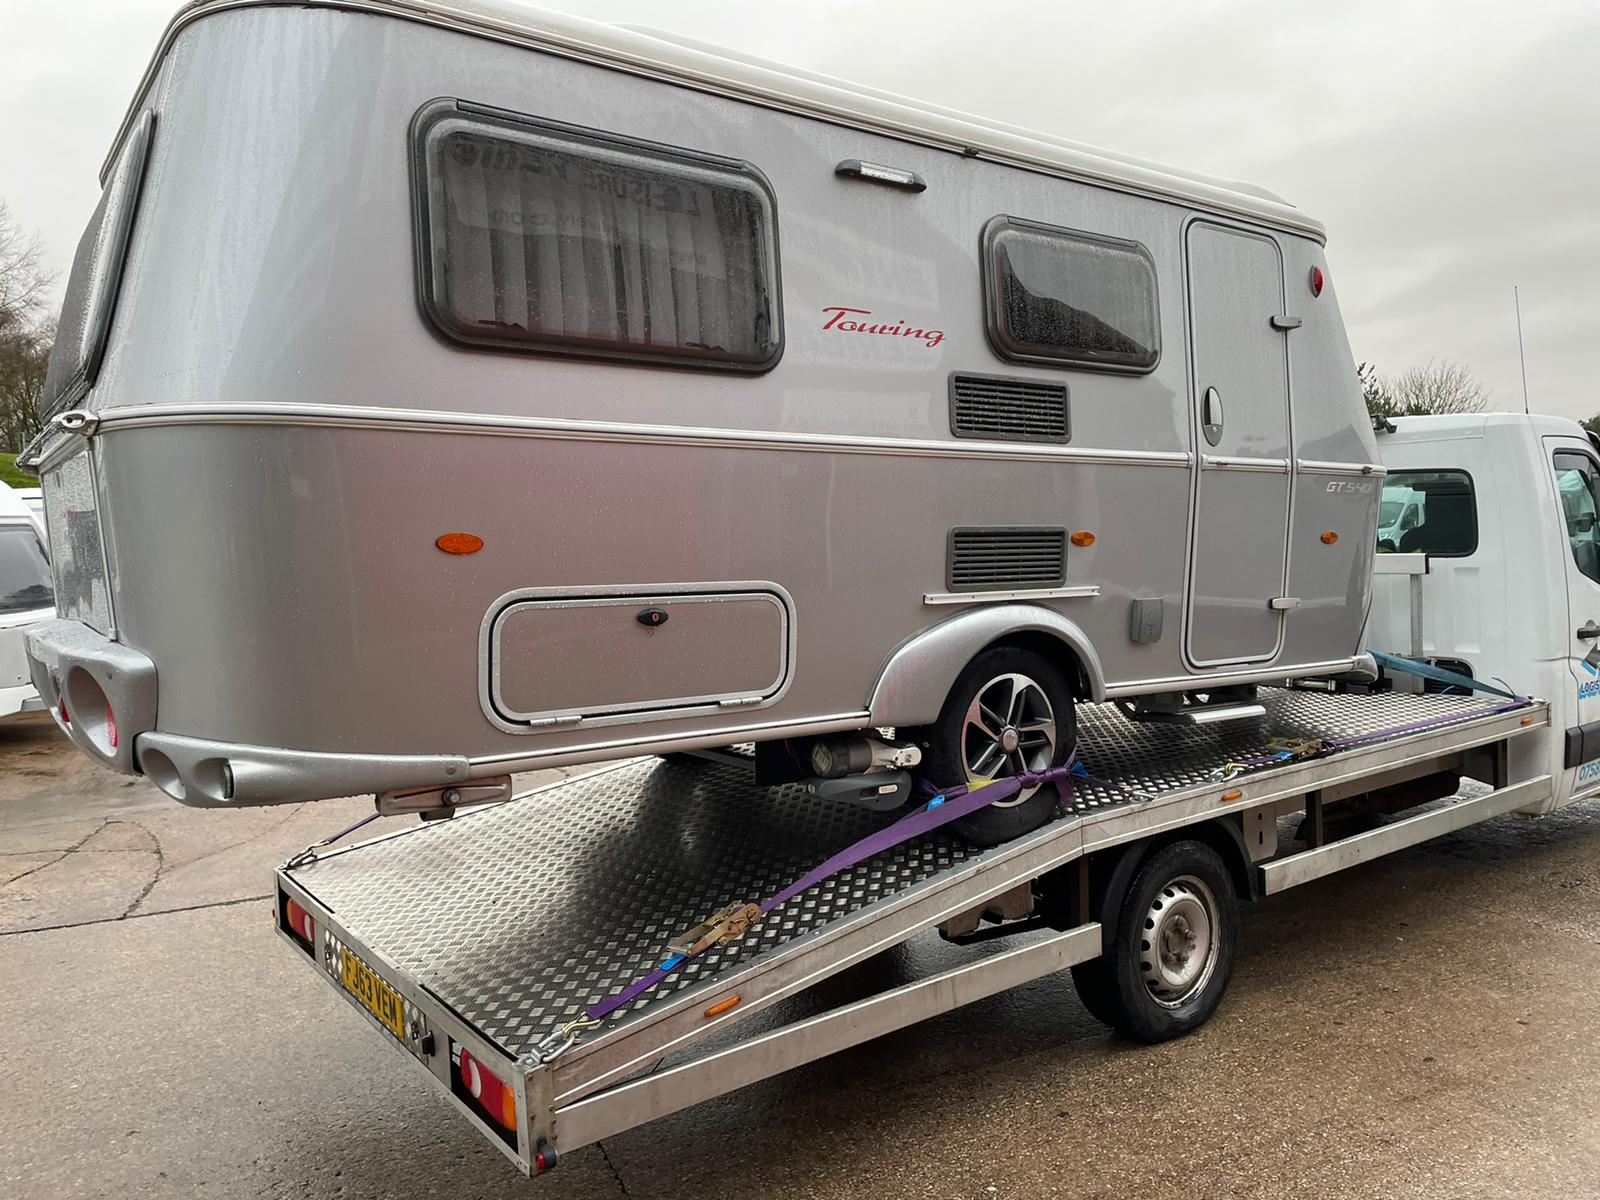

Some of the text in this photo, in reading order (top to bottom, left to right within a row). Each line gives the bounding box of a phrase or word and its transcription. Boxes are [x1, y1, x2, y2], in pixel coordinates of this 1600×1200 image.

[822, 307, 946, 347] Touring
[1326, 481, 1373, 494] GT 540
